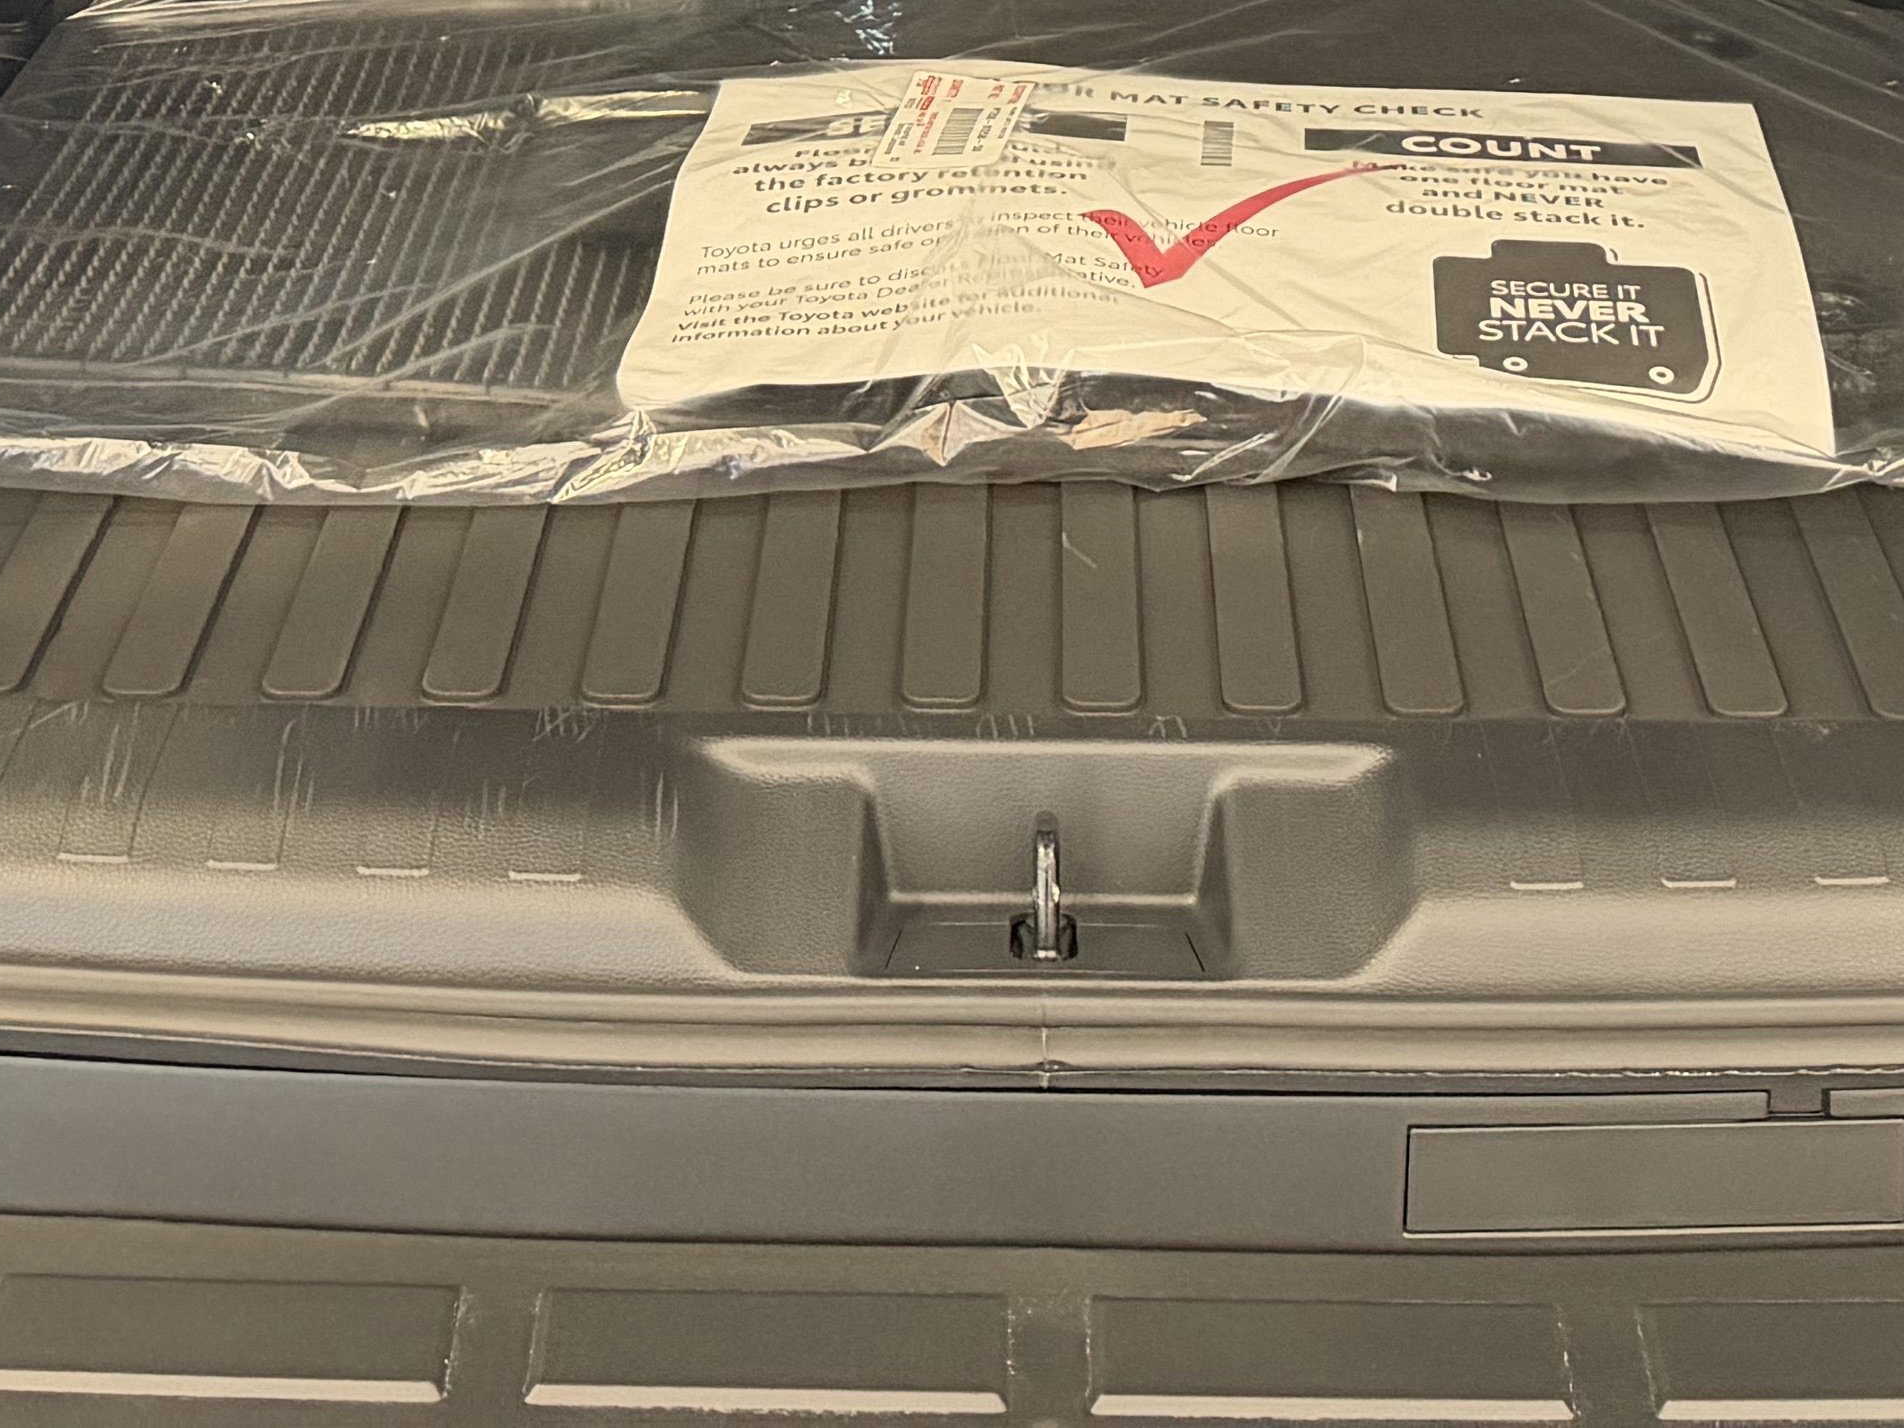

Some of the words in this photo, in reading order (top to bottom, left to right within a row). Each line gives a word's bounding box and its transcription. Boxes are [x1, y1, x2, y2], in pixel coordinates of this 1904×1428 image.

[1110, 91, 1188, 105] MAT
[1202, 96, 1341, 114] SAFETY
[1353, 103, 1484, 119] CHECK
[1401, 136, 1601, 161] COUNT
[733, 160, 838, 174] always
[1592, 172, 1668, 185] have
[754, 177, 805, 192] the
[816, 170, 928, 187] factory
[1399, 174, 1459, 185] one
[1470, 176, 1549, 190] floor
[1559, 183, 1624, 195] mat
[766, 195, 839, 213] clips
[849, 192, 883, 204] or
[891, 183, 1067, 204] grommets.
[1422, 187, 1483, 200] and
[1494, 192, 1605, 209] NEVER
[1386, 200, 1503, 221] double
[1514, 209, 1601, 226] stack
[1610, 214, 1645, 228] it.
[701, 241, 771, 260] Toyota
[779, 233, 840, 250] urges
[848, 226, 873, 242] all
[881, 219, 954, 239] drivers
[991, 210, 1073, 223] inspect
[1138, 218, 1218, 233] vehicle
[1226, 223, 1279, 238] floor
[697, 260, 750, 275] mats
[758, 257, 779, 269] to
[787, 246, 861, 265] ensure
[869, 239, 913, 255] safe
[1037, 223, 1059, 235] of
[689, 290, 760, 305] Please
[768, 284, 796, 297] be
[804, 278, 851, 294] sure
[859, 274, 881, 287] to
[1046, 252, 1086, 265] Mat
[1094, 256, 1164, 278] Safety
[1490, 279, 1606, 298] SECURE
[1617, 284, 1641, 300] IT
[678, 317, 726, 331] Visit
[733, 314, 770, 325] the
[778, 310, 854, 324] Toyota
[861, 297, 950, 318] website
[684, 304, 730, 318] with
[736, 297, 788, 313] your
[796, 292, 867, 307] Toyota
[1489, 297, 1650, 323] NEVER
[817, 319, 888, 336] about
[893, 311, 946, 331] your
[1478, 319, 1621, 346] STACK
[1629, 324, 1664, 347] IT
